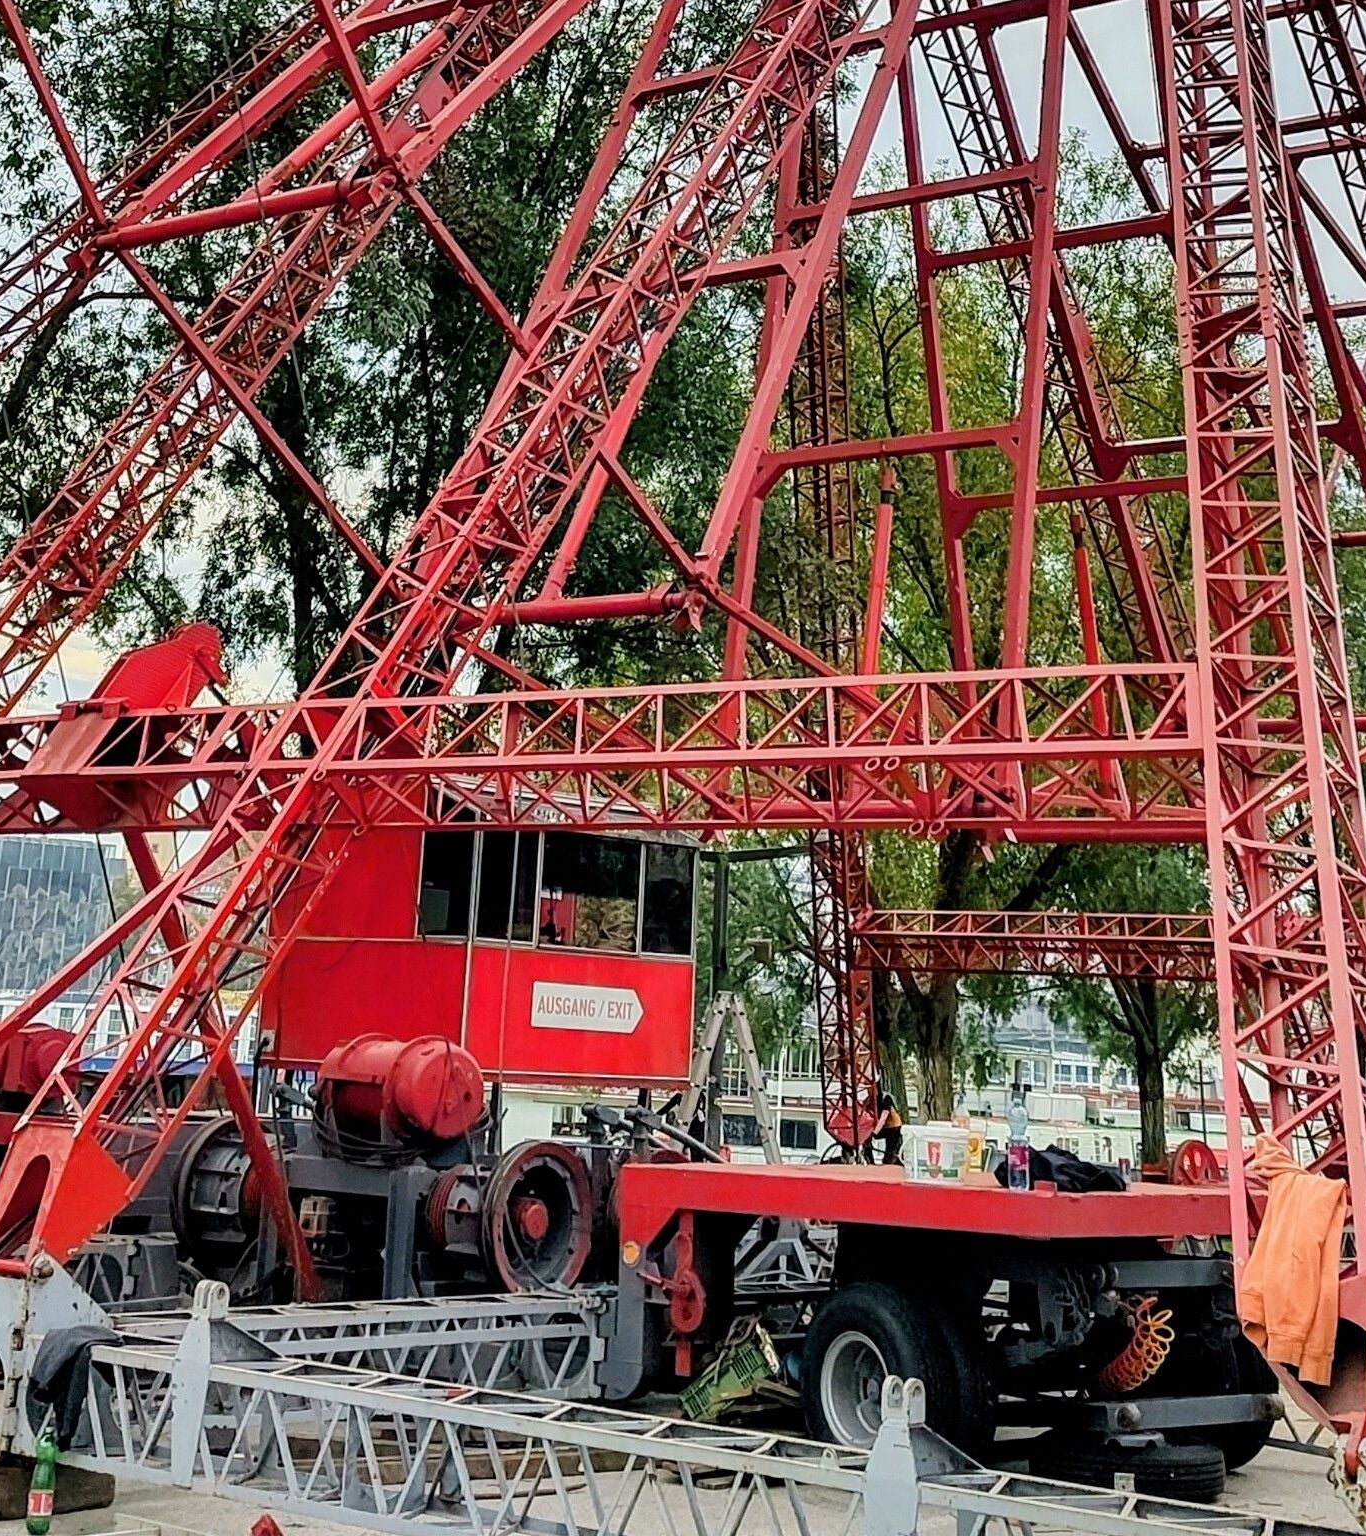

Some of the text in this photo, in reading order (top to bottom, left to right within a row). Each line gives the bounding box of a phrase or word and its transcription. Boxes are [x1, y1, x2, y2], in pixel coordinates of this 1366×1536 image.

[537, 995, 634, 1020] AUSGANG / EXIT
